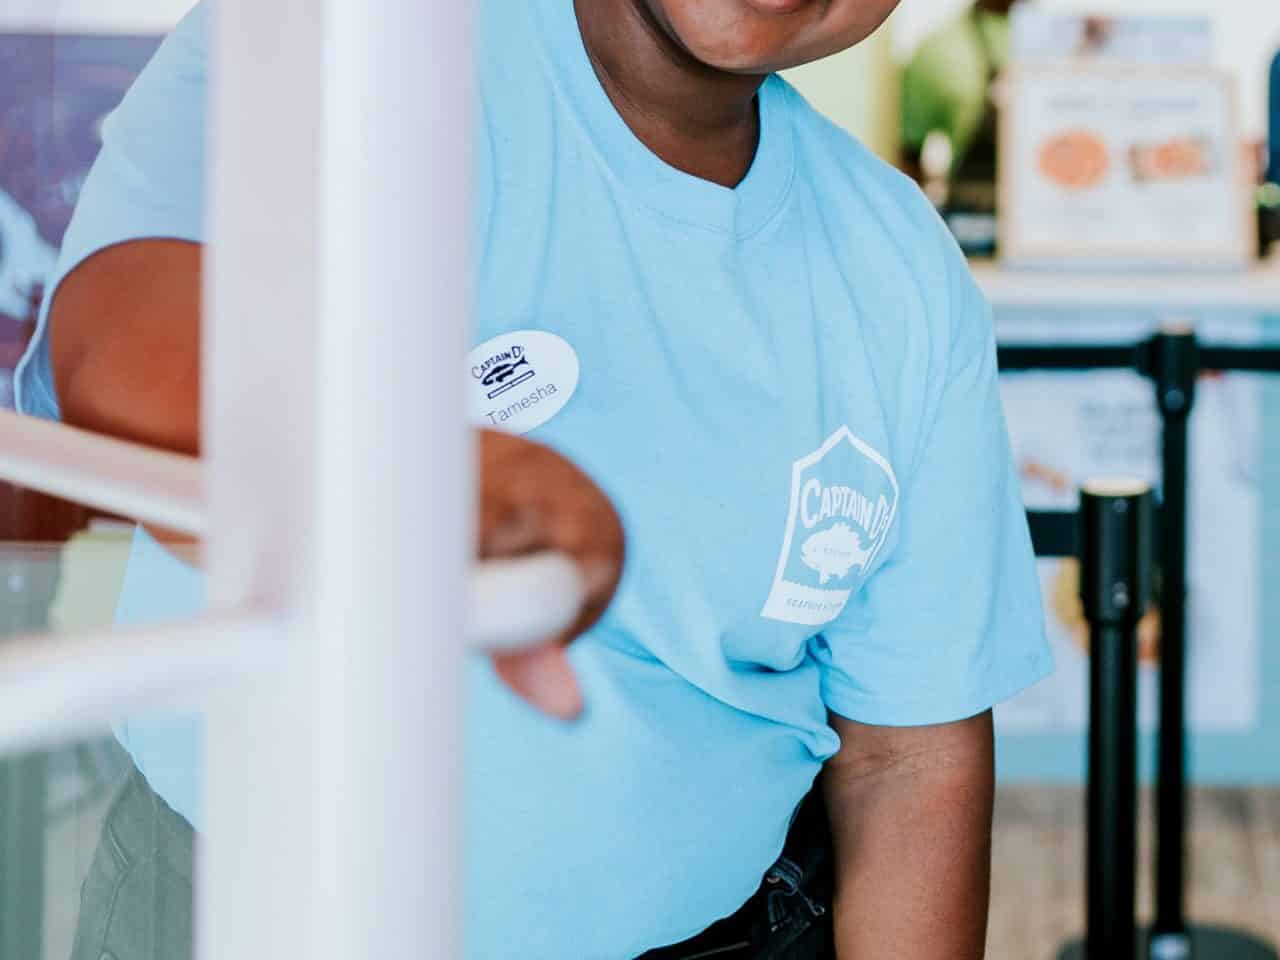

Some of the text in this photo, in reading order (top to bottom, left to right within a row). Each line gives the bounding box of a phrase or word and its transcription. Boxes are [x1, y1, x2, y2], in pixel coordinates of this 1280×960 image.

[471, 351, 512, 380] CAPTAIN
[485, 383, 558, 425] Tamesha
[800, 478, 874, 531] CAPTAIN
